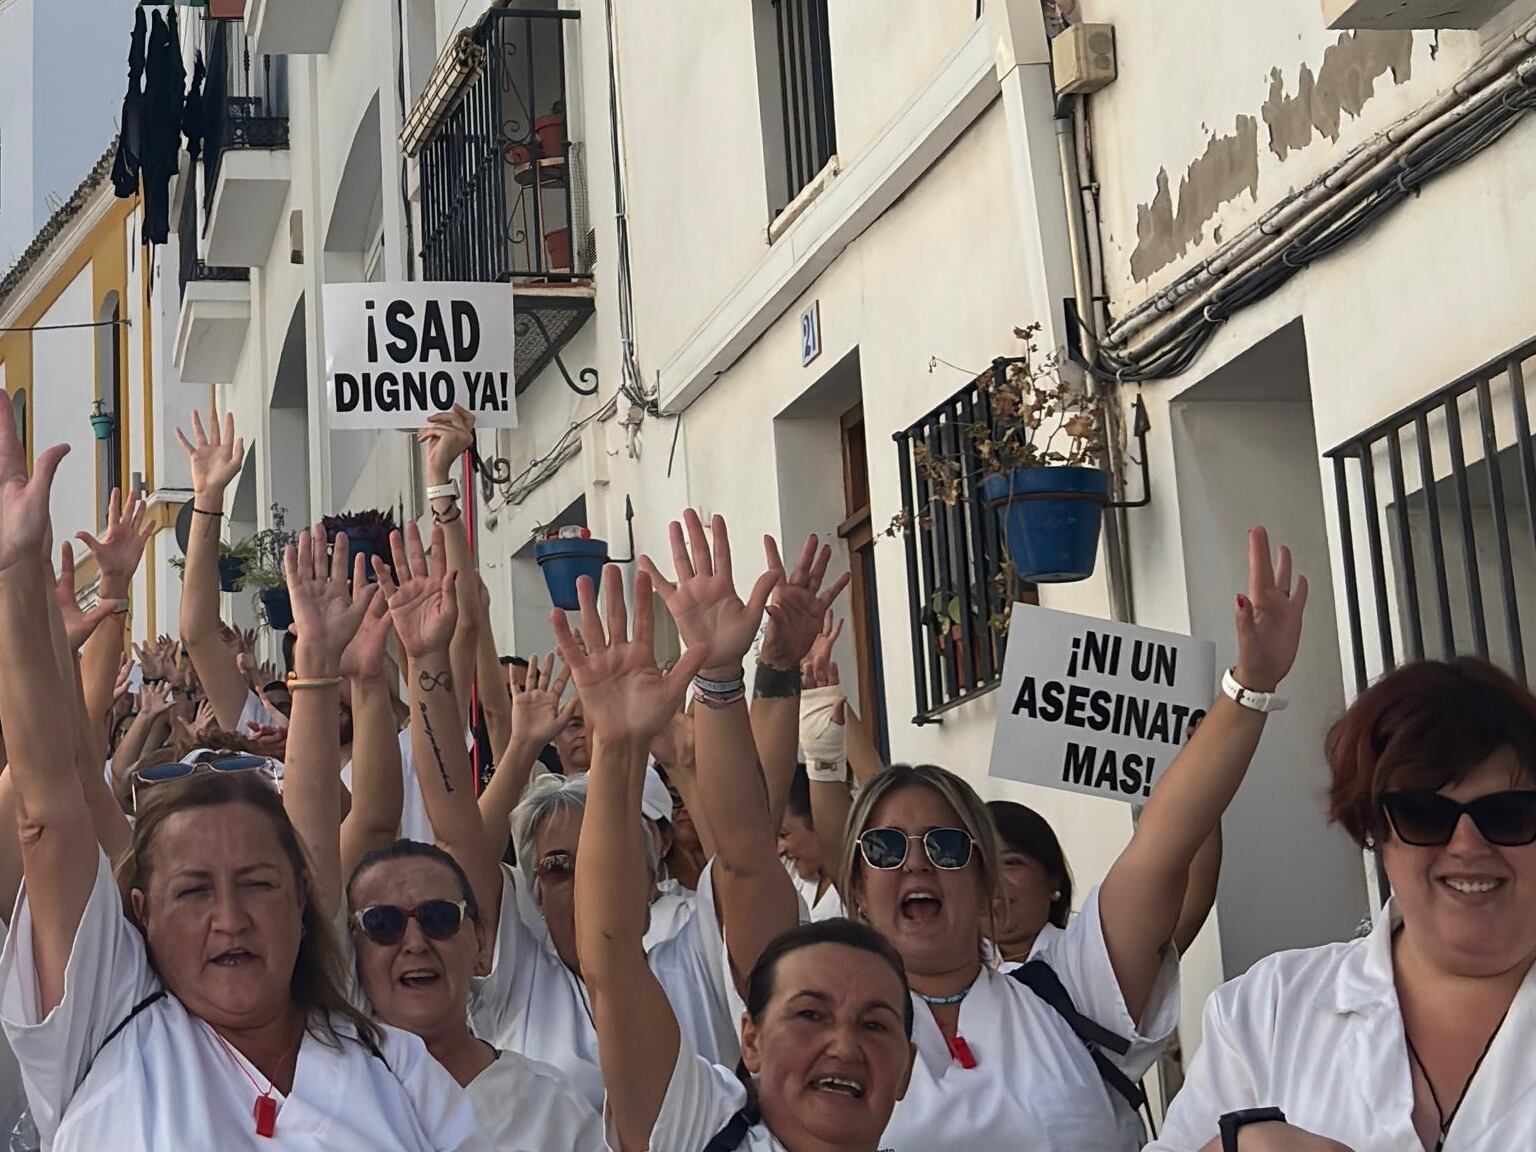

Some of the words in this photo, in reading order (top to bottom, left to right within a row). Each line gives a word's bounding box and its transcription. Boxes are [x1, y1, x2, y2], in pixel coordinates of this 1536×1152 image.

[365, 299, 480, 364] ¡SAD
[334, 370, 456, 413] DIGNO
[463, 371, 509, 411] YA!
[1067, 630, 1122, 677] ¡NI
[1131, 640, 1177, 687] UN
[1062, 742, 1156, 797] MAS!
